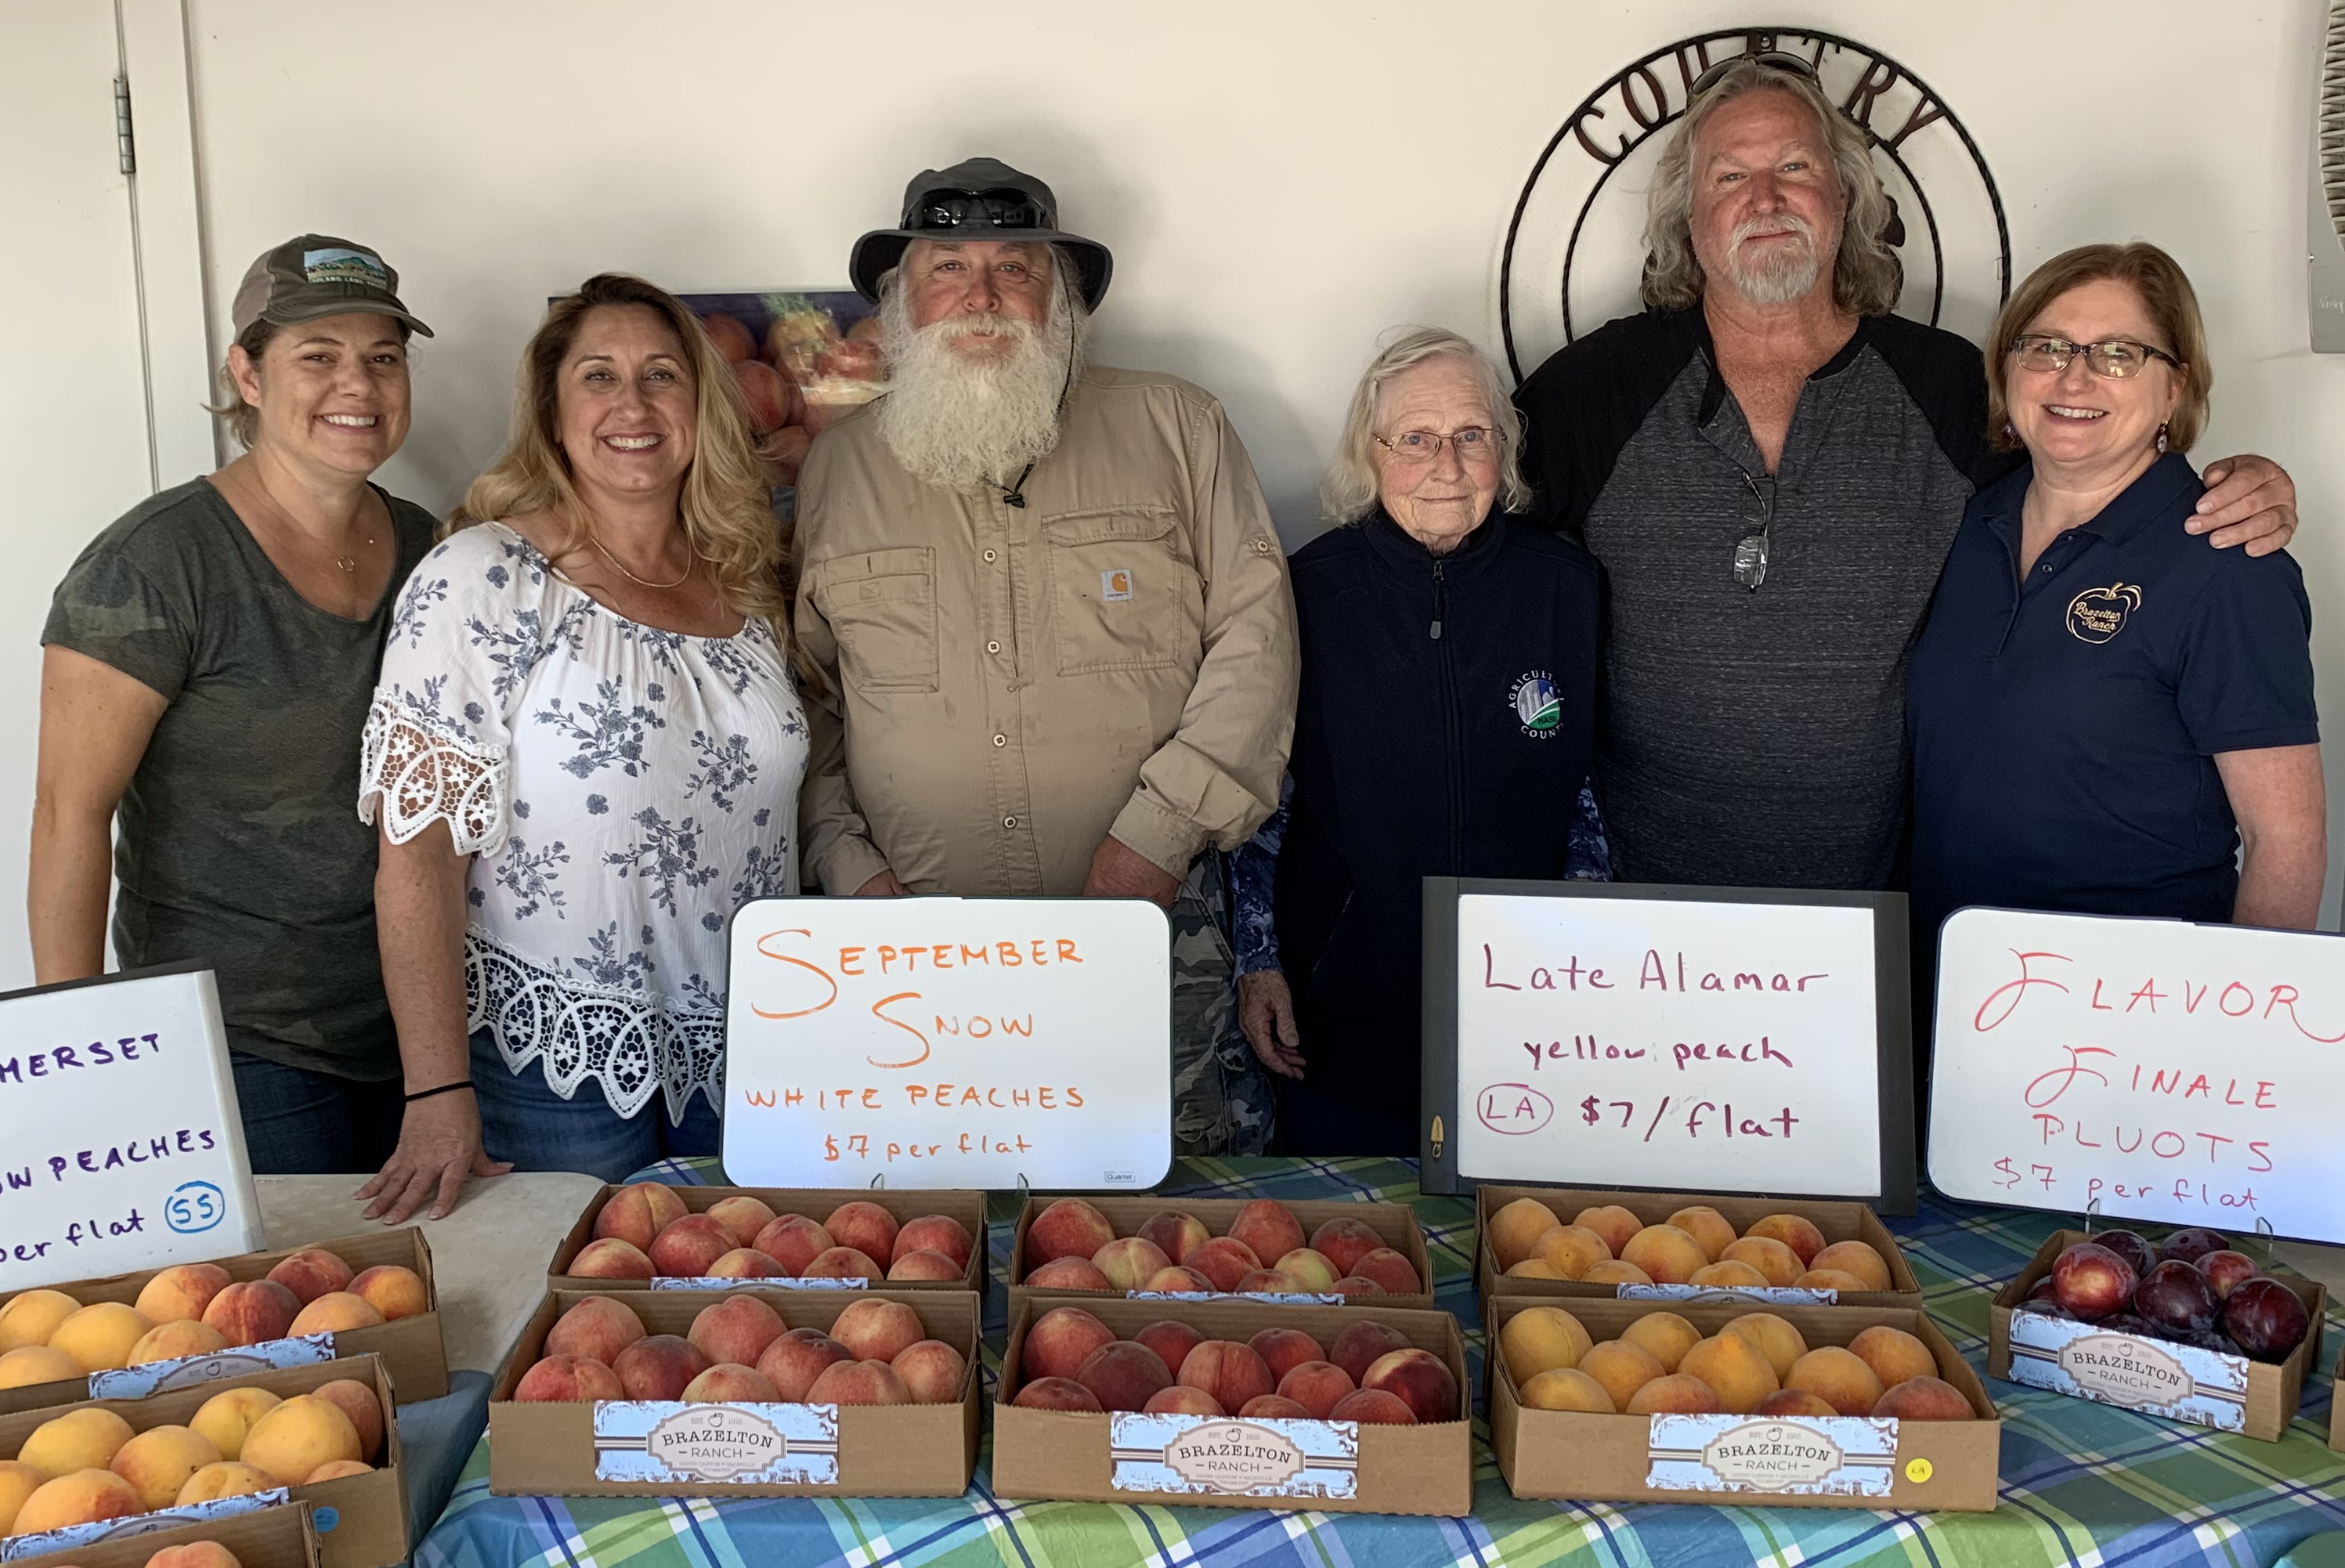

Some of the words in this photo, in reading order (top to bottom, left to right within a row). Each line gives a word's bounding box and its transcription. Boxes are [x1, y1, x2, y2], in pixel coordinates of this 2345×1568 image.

[2082, 616, 2117, 633] Ranch
[751, 928, 1084, 1020] SEPTEMBER
[1483, 942, 1615, 991] Late
[1639, 948, 1829, 992] Alamar
[1974, 948, 2345, 1043] FLAVOR
[866, 992, 1033, 1069] SNOW
[1523, 1035, 1646, 1071] yellow
[1674, 1036, 1794, 1068] peach
[2025, 1044, 2277, 1109] FINALE
[746, 1088, 883, 1110] WHITE
[905, 1083, 1085, 1110] PEACHES
[1486, 1096, 1536, 1120] LA
[48, 1129, 215, 1183] PEACHES
[887, 1141, 941, 1163] per
[958, 1133, 1033, 1154] flat
[2032, 1114, 2274, 1172] PLUOTS
[1993, 1156, 2057, 1191] $7
[2089, 1178, 2155, 1200] per
[2173, 1180, 2260, 1212] flat
[172, 1193, 214, 1225] SS
[66, 1208, 145, 1247] flat
[2072, 1353, 2181, 1386] BRAZELTON
[2099, 1370, 2149, 1390] RANCH
[661, 1429, 775, 1449] BRAZELTON
[691, 1447, 743, 1458] RANCH
[1178, 1444, 1292, 1464] BRAZELTON
[1717, 1443, 1832, 1462] BRAZELTON
[1208, 1461, 1259, 1472] RANCH
[1745, 1460, 1798, 1471] RANCH
